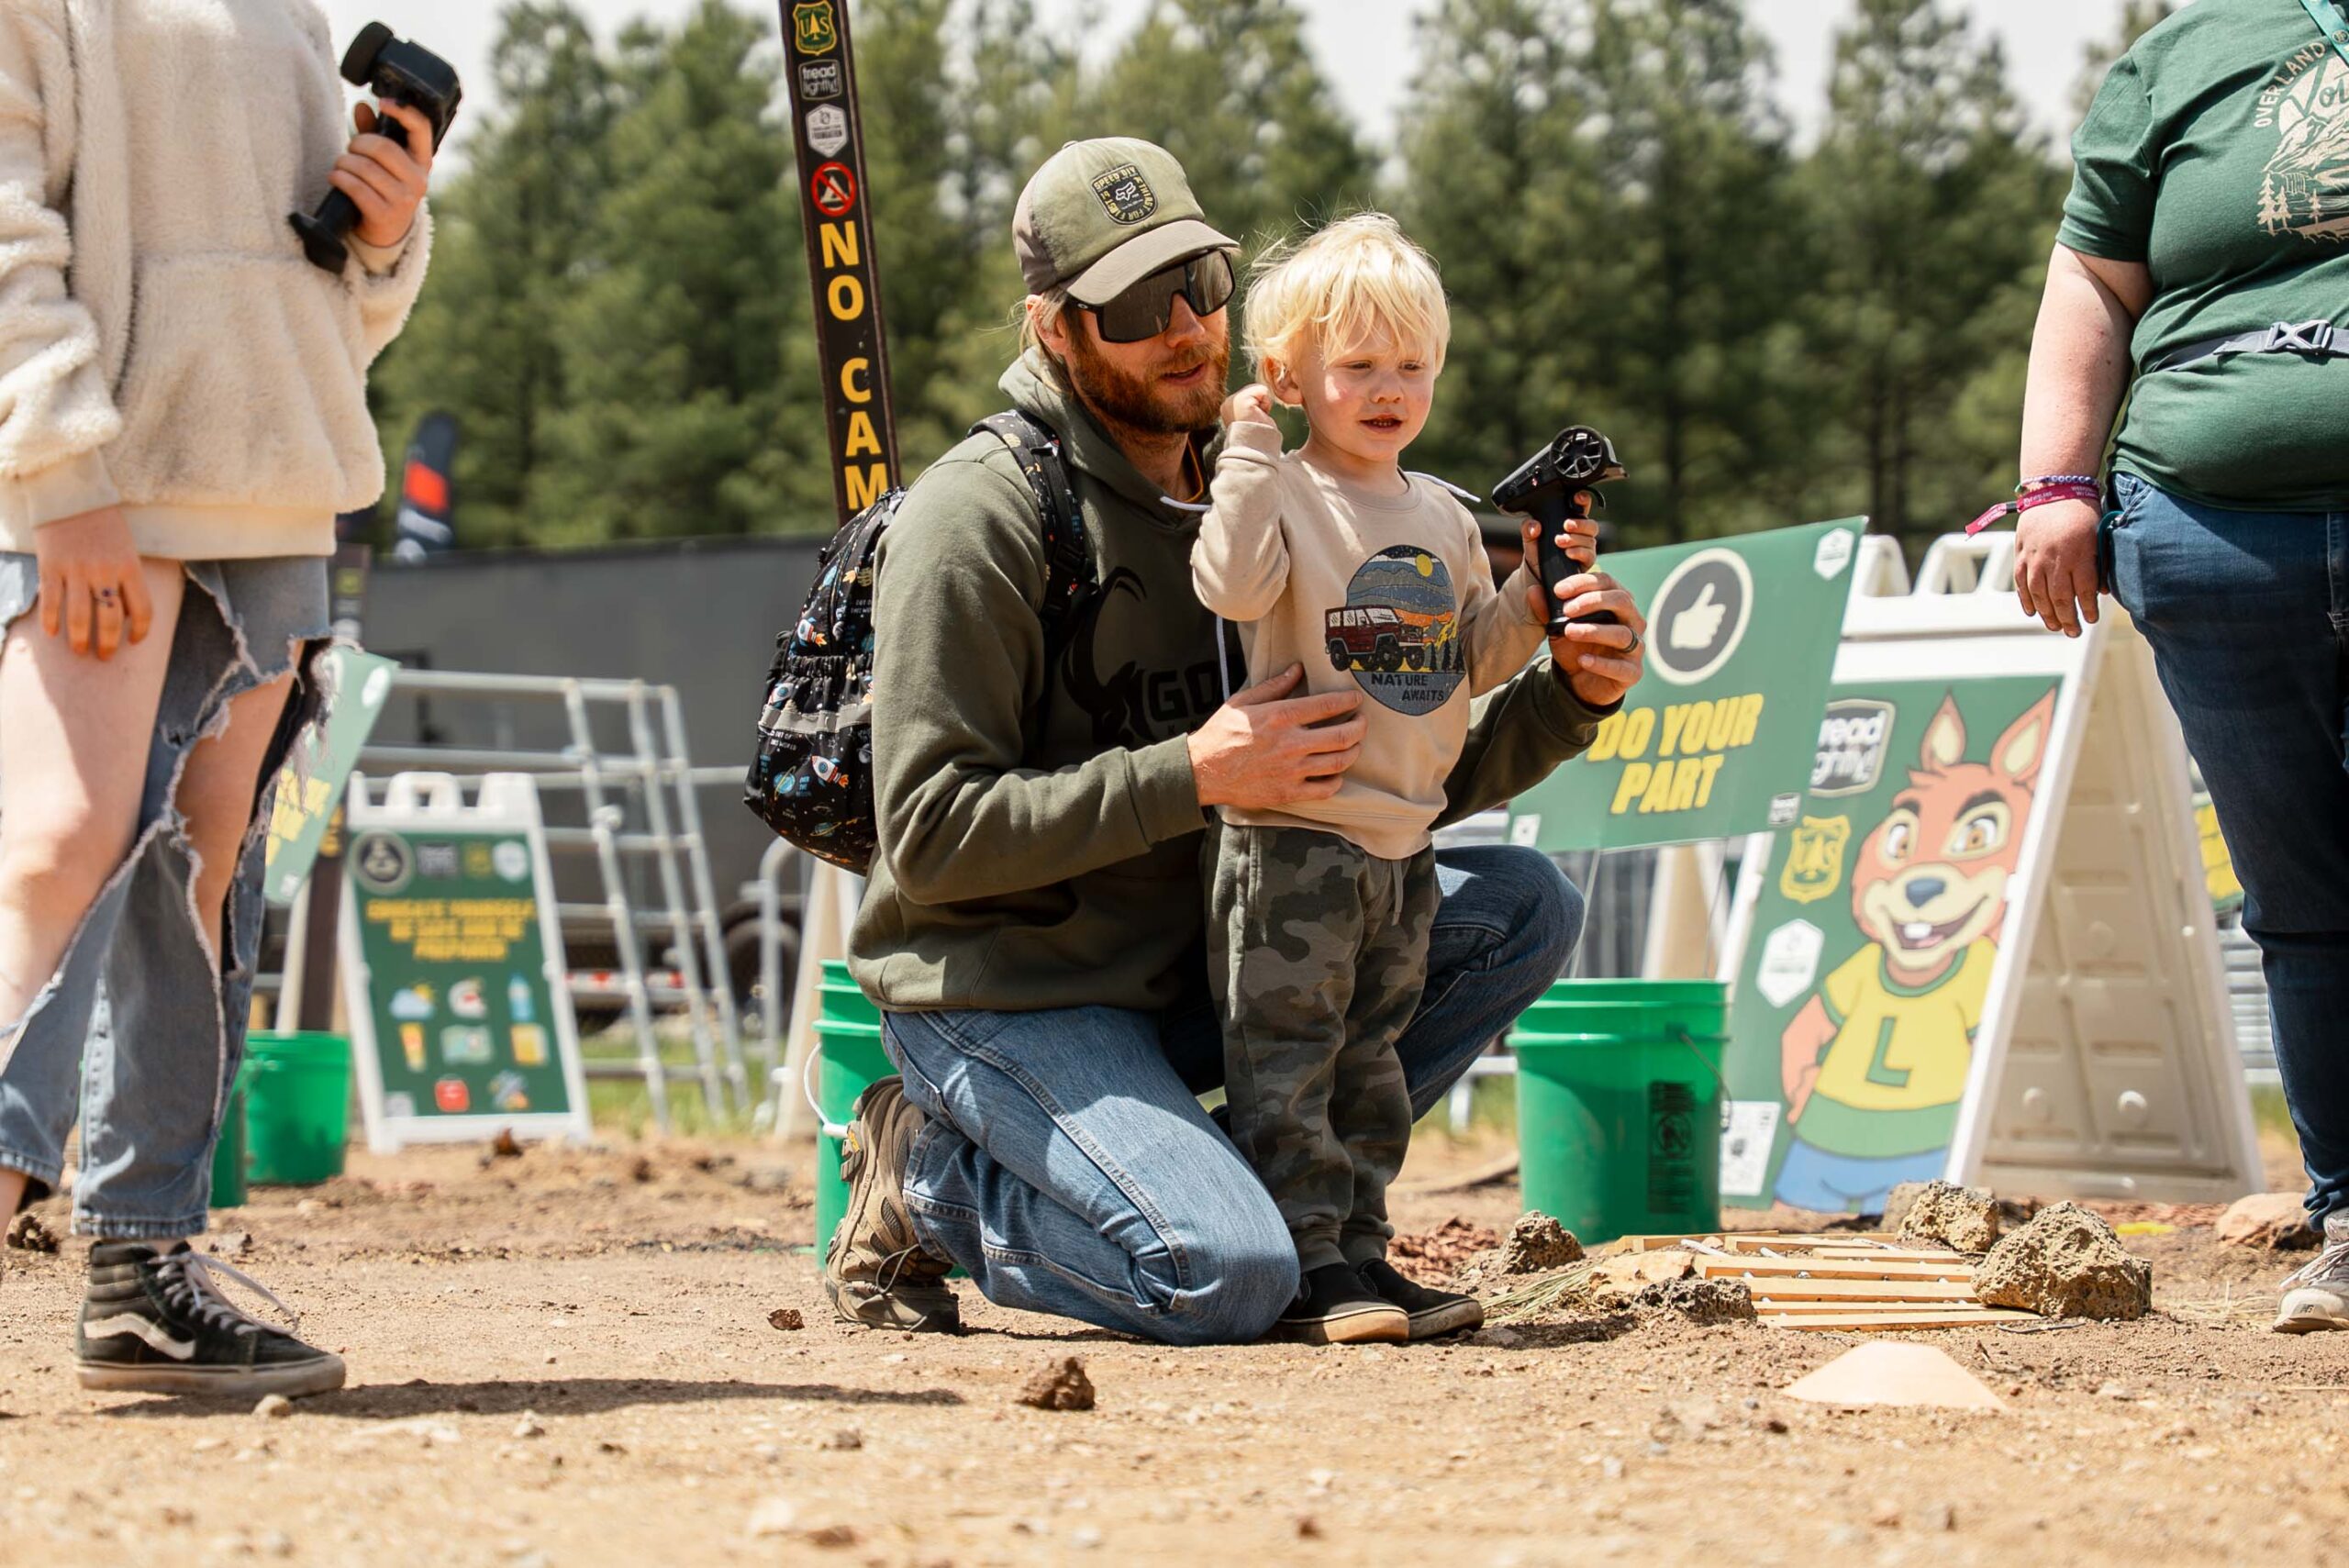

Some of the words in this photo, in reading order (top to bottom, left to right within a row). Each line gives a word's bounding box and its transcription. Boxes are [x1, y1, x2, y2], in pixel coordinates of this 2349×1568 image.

[802, 63, 837, 80] tread
[2254, 41, 2326, 128] OVERLAND
[1094, 172, 1119, 189] SPEED
[819, 220, 865, 321] NO
[1371, 673, 1429, 687] NATURE
[1401, 689, 1444, 702] AWAITS
[1586, 706, 1656, 762] DO
[1658, 693, 1765, 758] YOUR
[1610, 753, 1725, 815] PART
[1865, 1016, 1912, 1088] L
